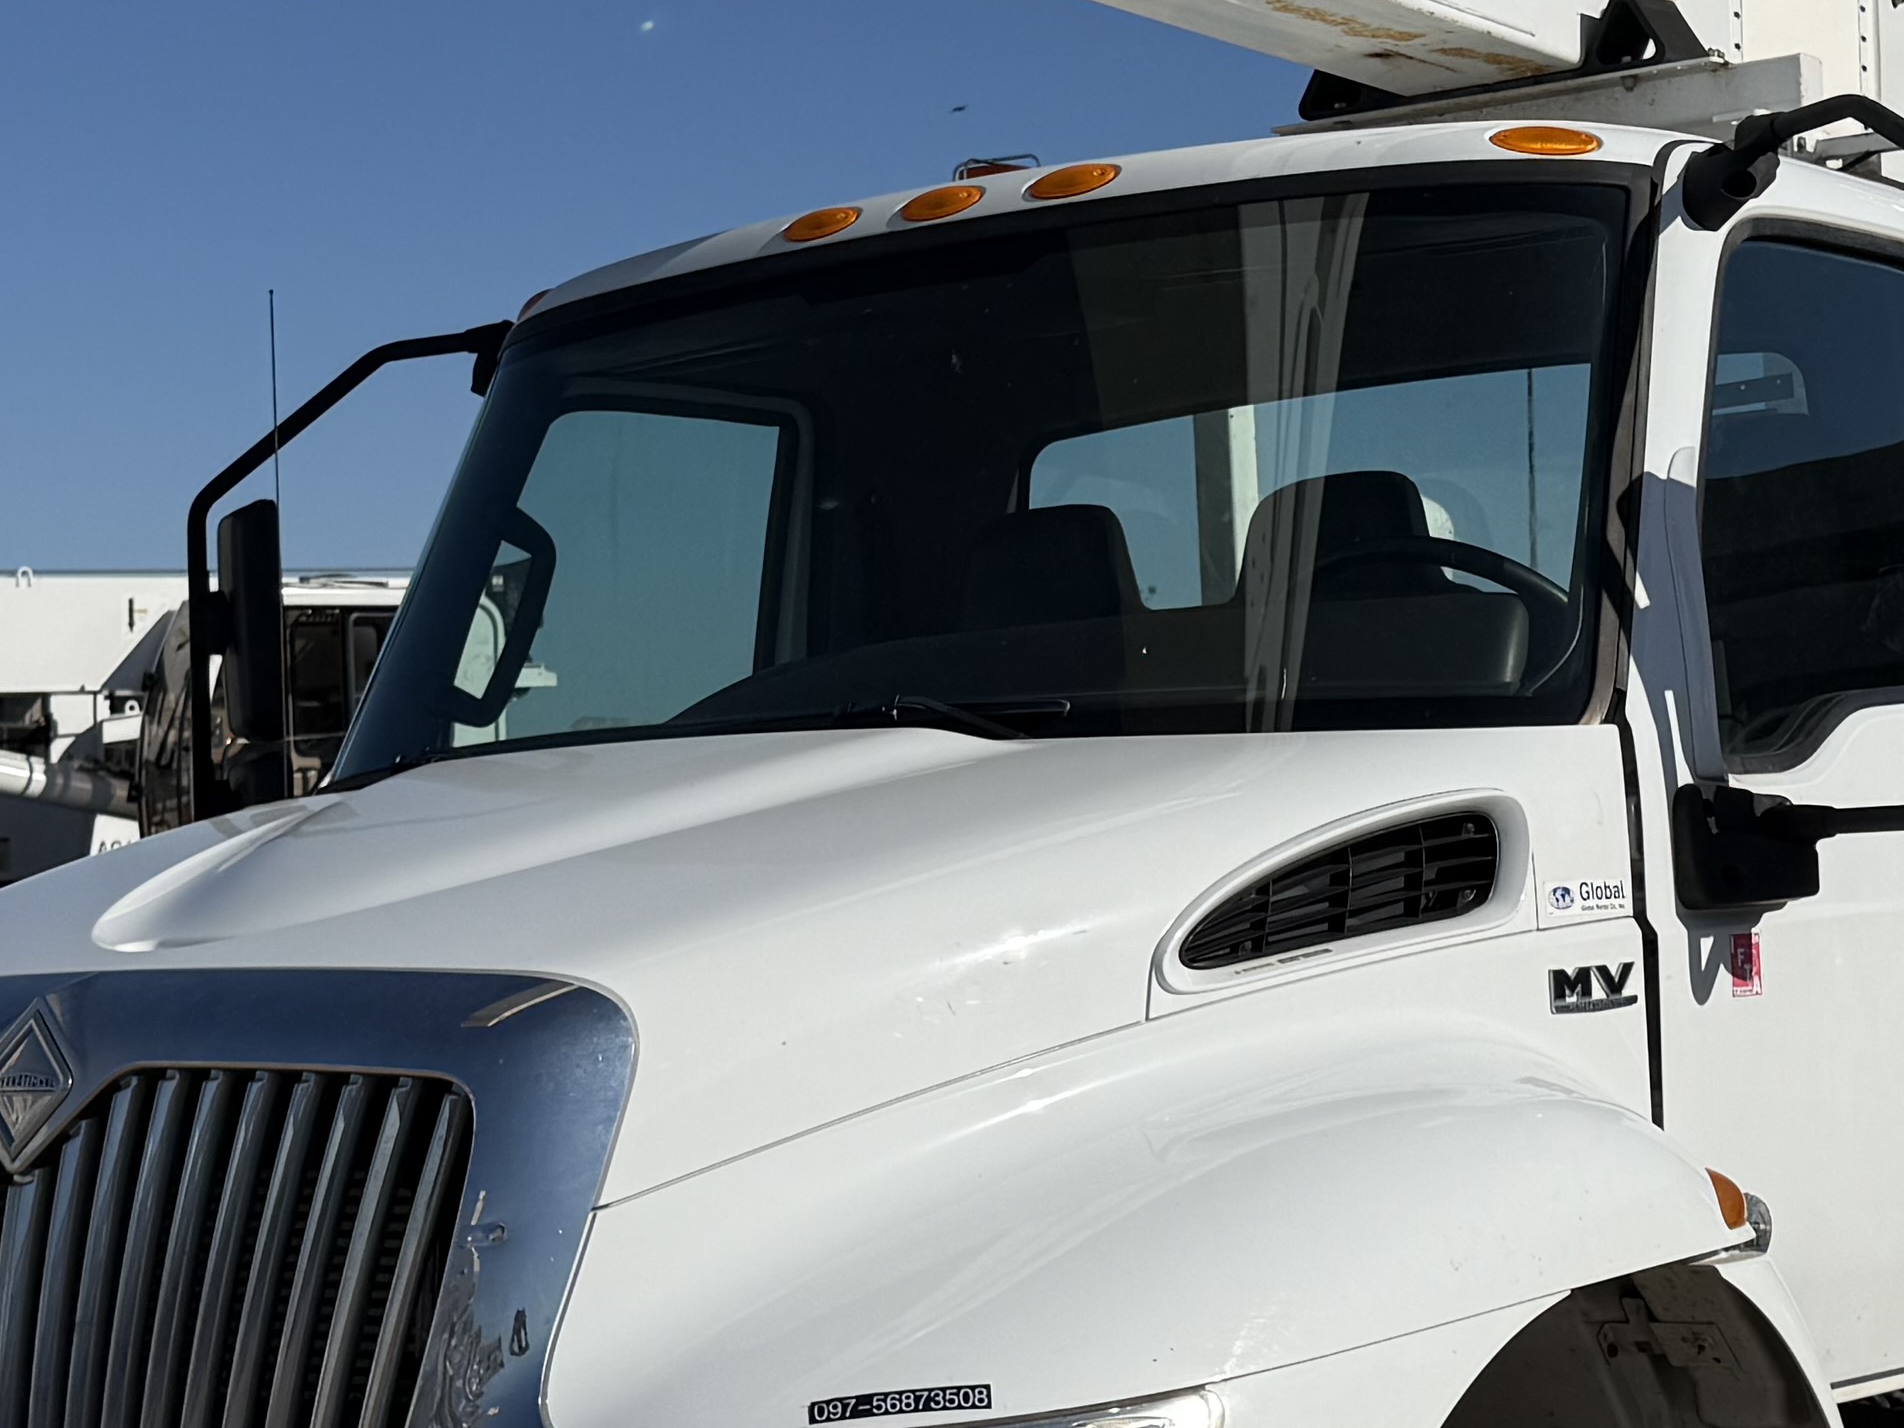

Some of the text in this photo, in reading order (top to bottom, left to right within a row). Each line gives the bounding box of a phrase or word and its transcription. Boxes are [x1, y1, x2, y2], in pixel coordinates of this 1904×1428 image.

[1579, 880, 1626, 901] Global
[1548, 961, 1635, 1002] MV
[814, 1387, 988, 1421] 097-56873508
